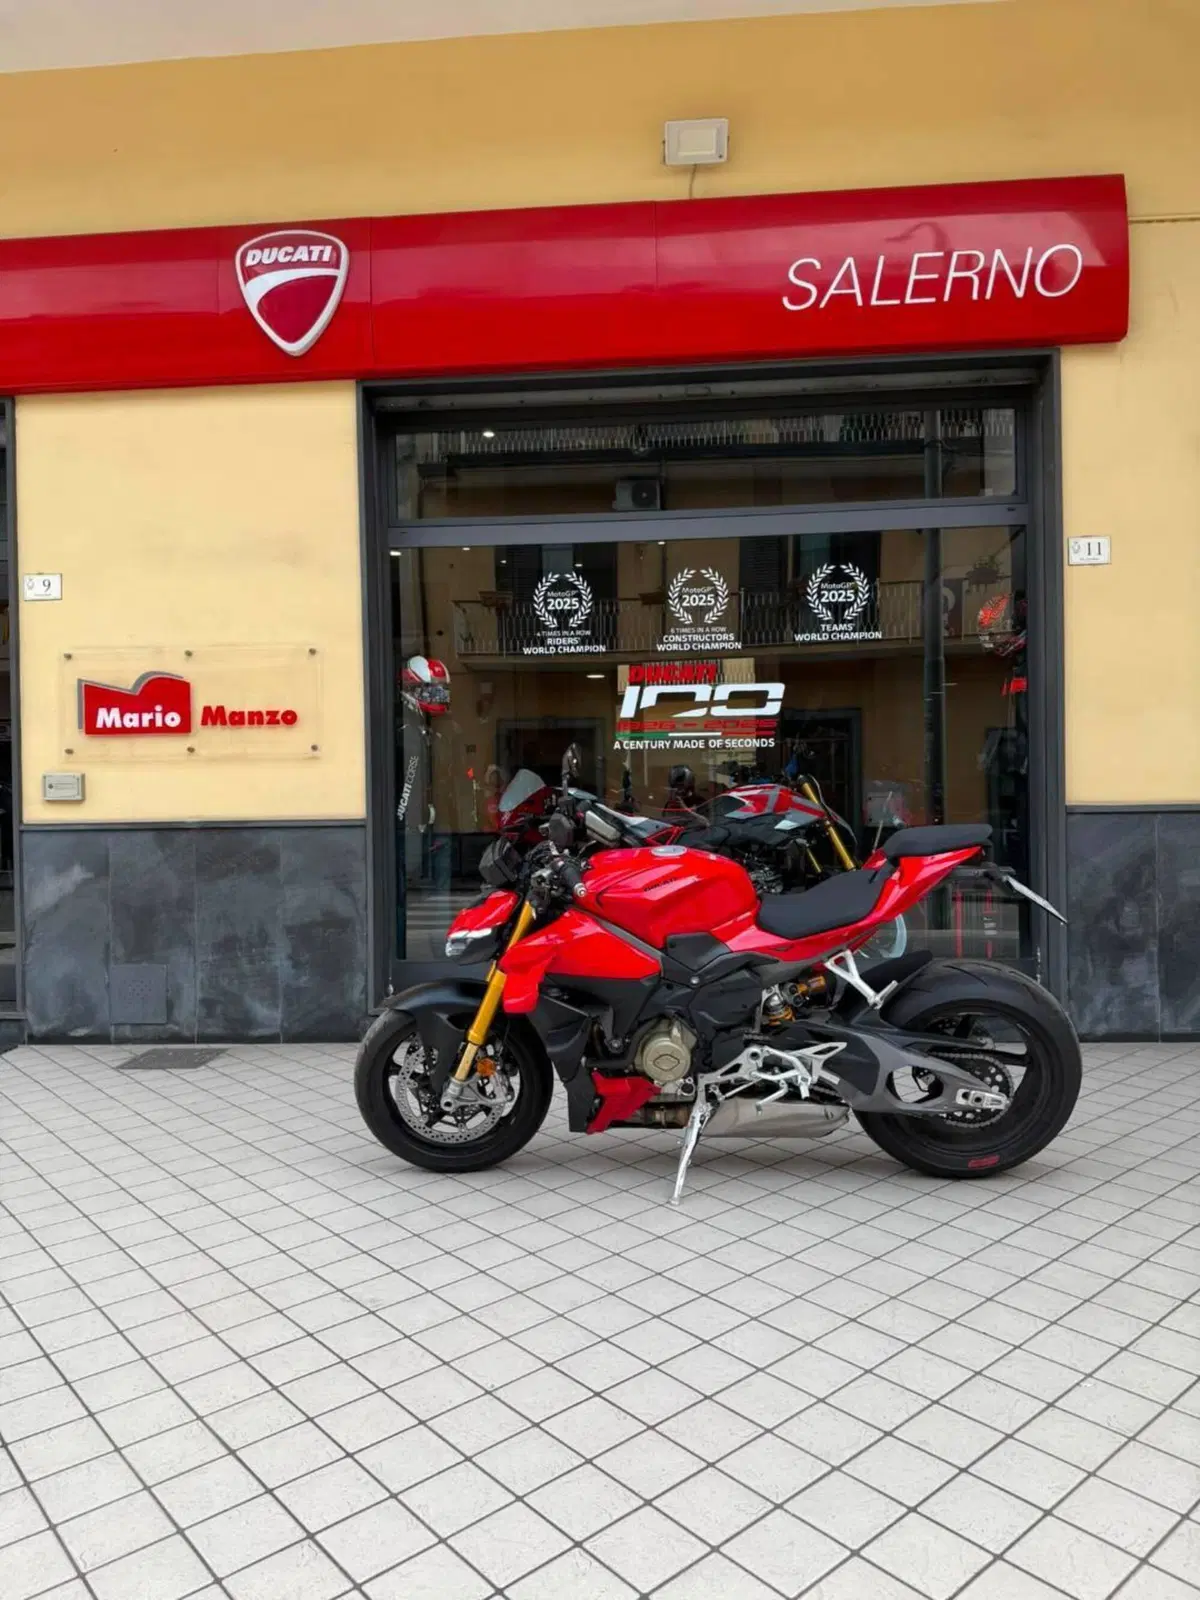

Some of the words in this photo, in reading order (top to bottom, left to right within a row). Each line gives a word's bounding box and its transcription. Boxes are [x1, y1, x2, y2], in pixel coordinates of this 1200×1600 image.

[245, 245, 333, 267] DUCATI
[782, 243, 1083, 311] SALERNO
[1087, 541, 1101, 556] 11
[42, 579, 51, 593] 9
[546, 597, 580, 610] 2025
[681, 593, 715, 607] 2025
[820, 590, 855, 603] 2025
[662, 633, 735, 643] CONSTRUCTORS
[794, 632, 829, 642] WORLD
[830, 631, 882, 640] CHAMPION
[522, 646, 556, 655] WORLD
[557, 644, 606, 654] CHAMPION
[656, 643, 691, 652] WORLD
[691, 642, 742, 651] CHAMPION
[628, 663, 718, 684] DUCATI
[619, 682, 786, 719] 100
[95, 705, 182, 729] Mario
[200, 705, 298, 727] Manzo
[613, 741, 621, 750] A
[623, 739, 671, 750] CENTURY
[672, 739, 705, 749] MADE
[708, 739, 723, 748] OF
[725, 737, 775, 748] SECONDS
